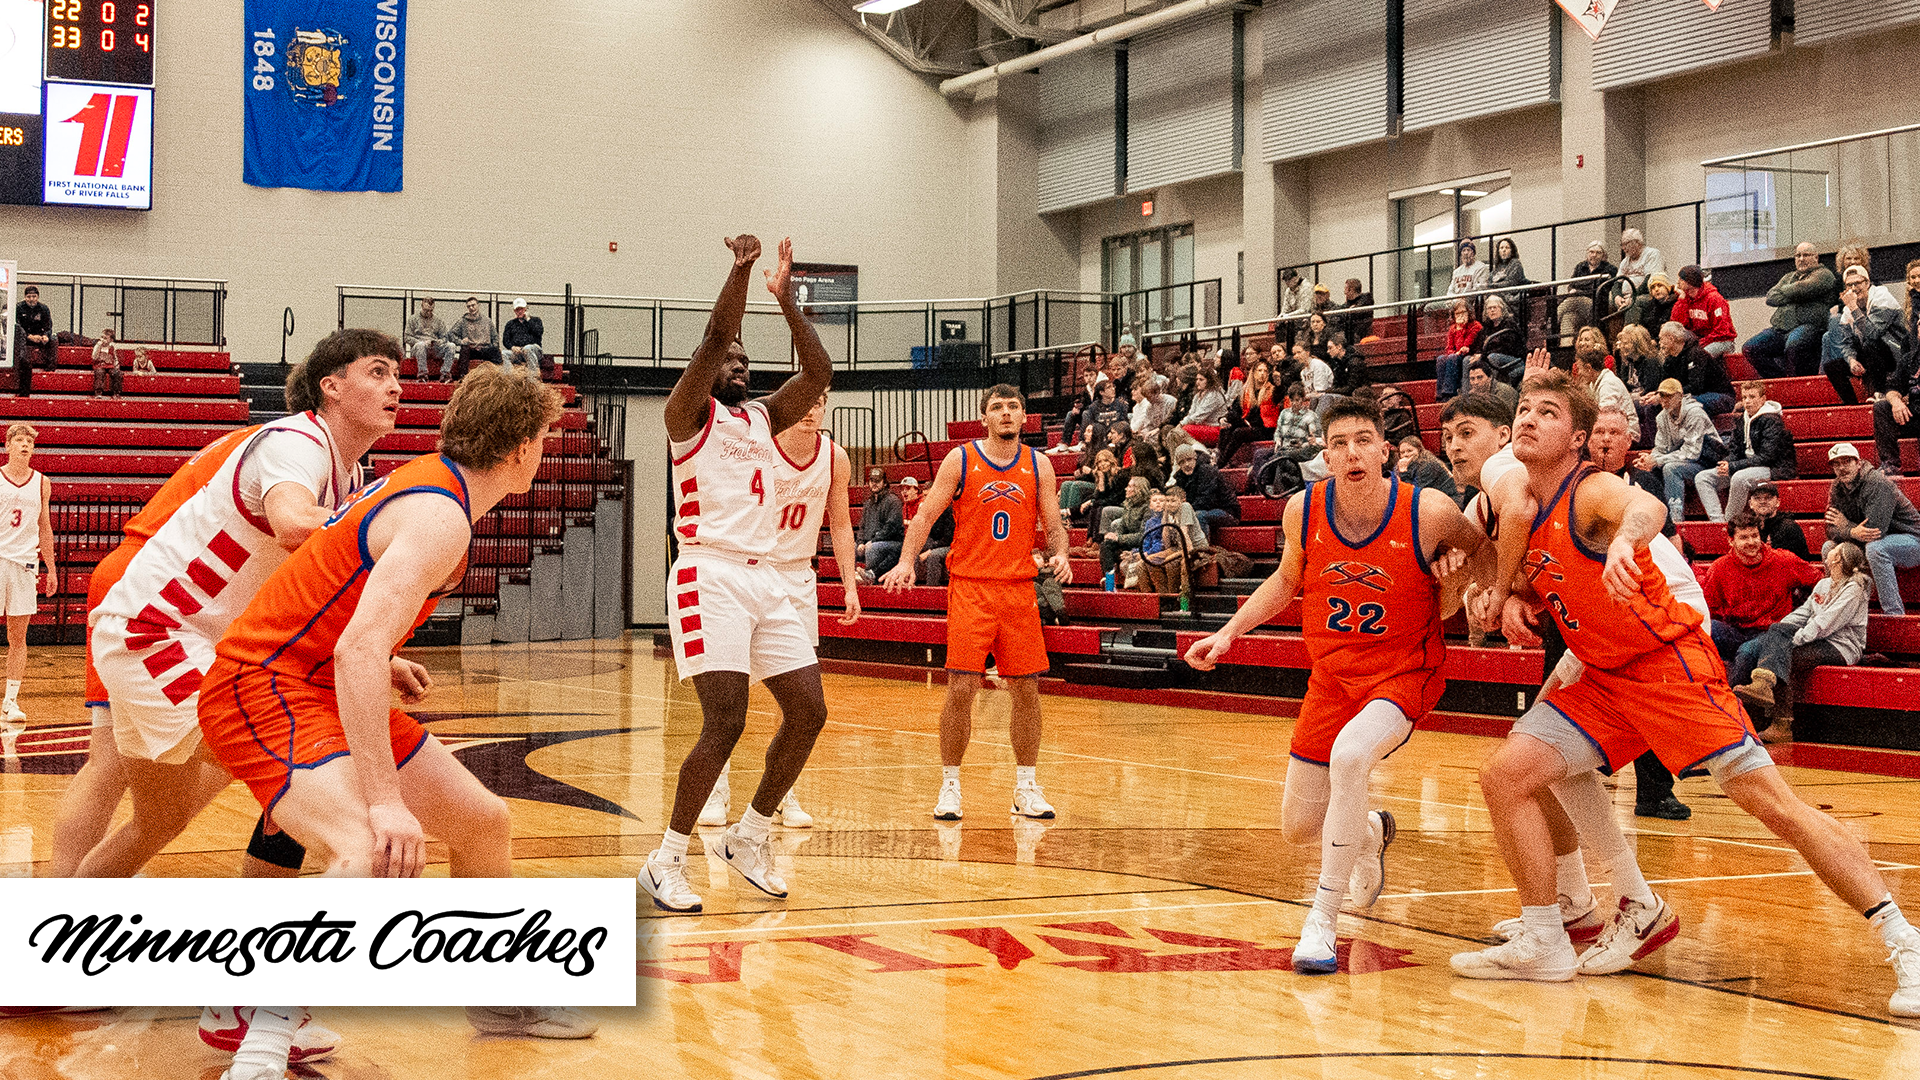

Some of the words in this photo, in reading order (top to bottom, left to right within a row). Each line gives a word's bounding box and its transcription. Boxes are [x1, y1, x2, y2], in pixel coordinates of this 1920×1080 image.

[52, 0, 81, 21] 22
[101, 1, 116, 24] 0
[134, 4, 150, 26] 2
[52, 25, 81, 49] 33
[101, 28, 116, 52] 0
[134, 33, 149, 53] 4
[252, 28, 276, 91] 1848
[372, 0, 399, 151] WISCONSIN
[48, 180, 71, 188] FIRST
[73, 182, 118, 191] NATIONAL
[121, 184, 146, 192] BANK
[79, 189, 104, 198] RIVER
[105, 191, 130, 199] FALLS
[720, 437, 773, 463] Falcon
[749, 467, 765, 507] 4
[10, 508, 22, 528] 3
[778, 502, 808, 531] 10
[992, 510, 1011, 541] 0
[1326, 596, 1388, 635] 22
